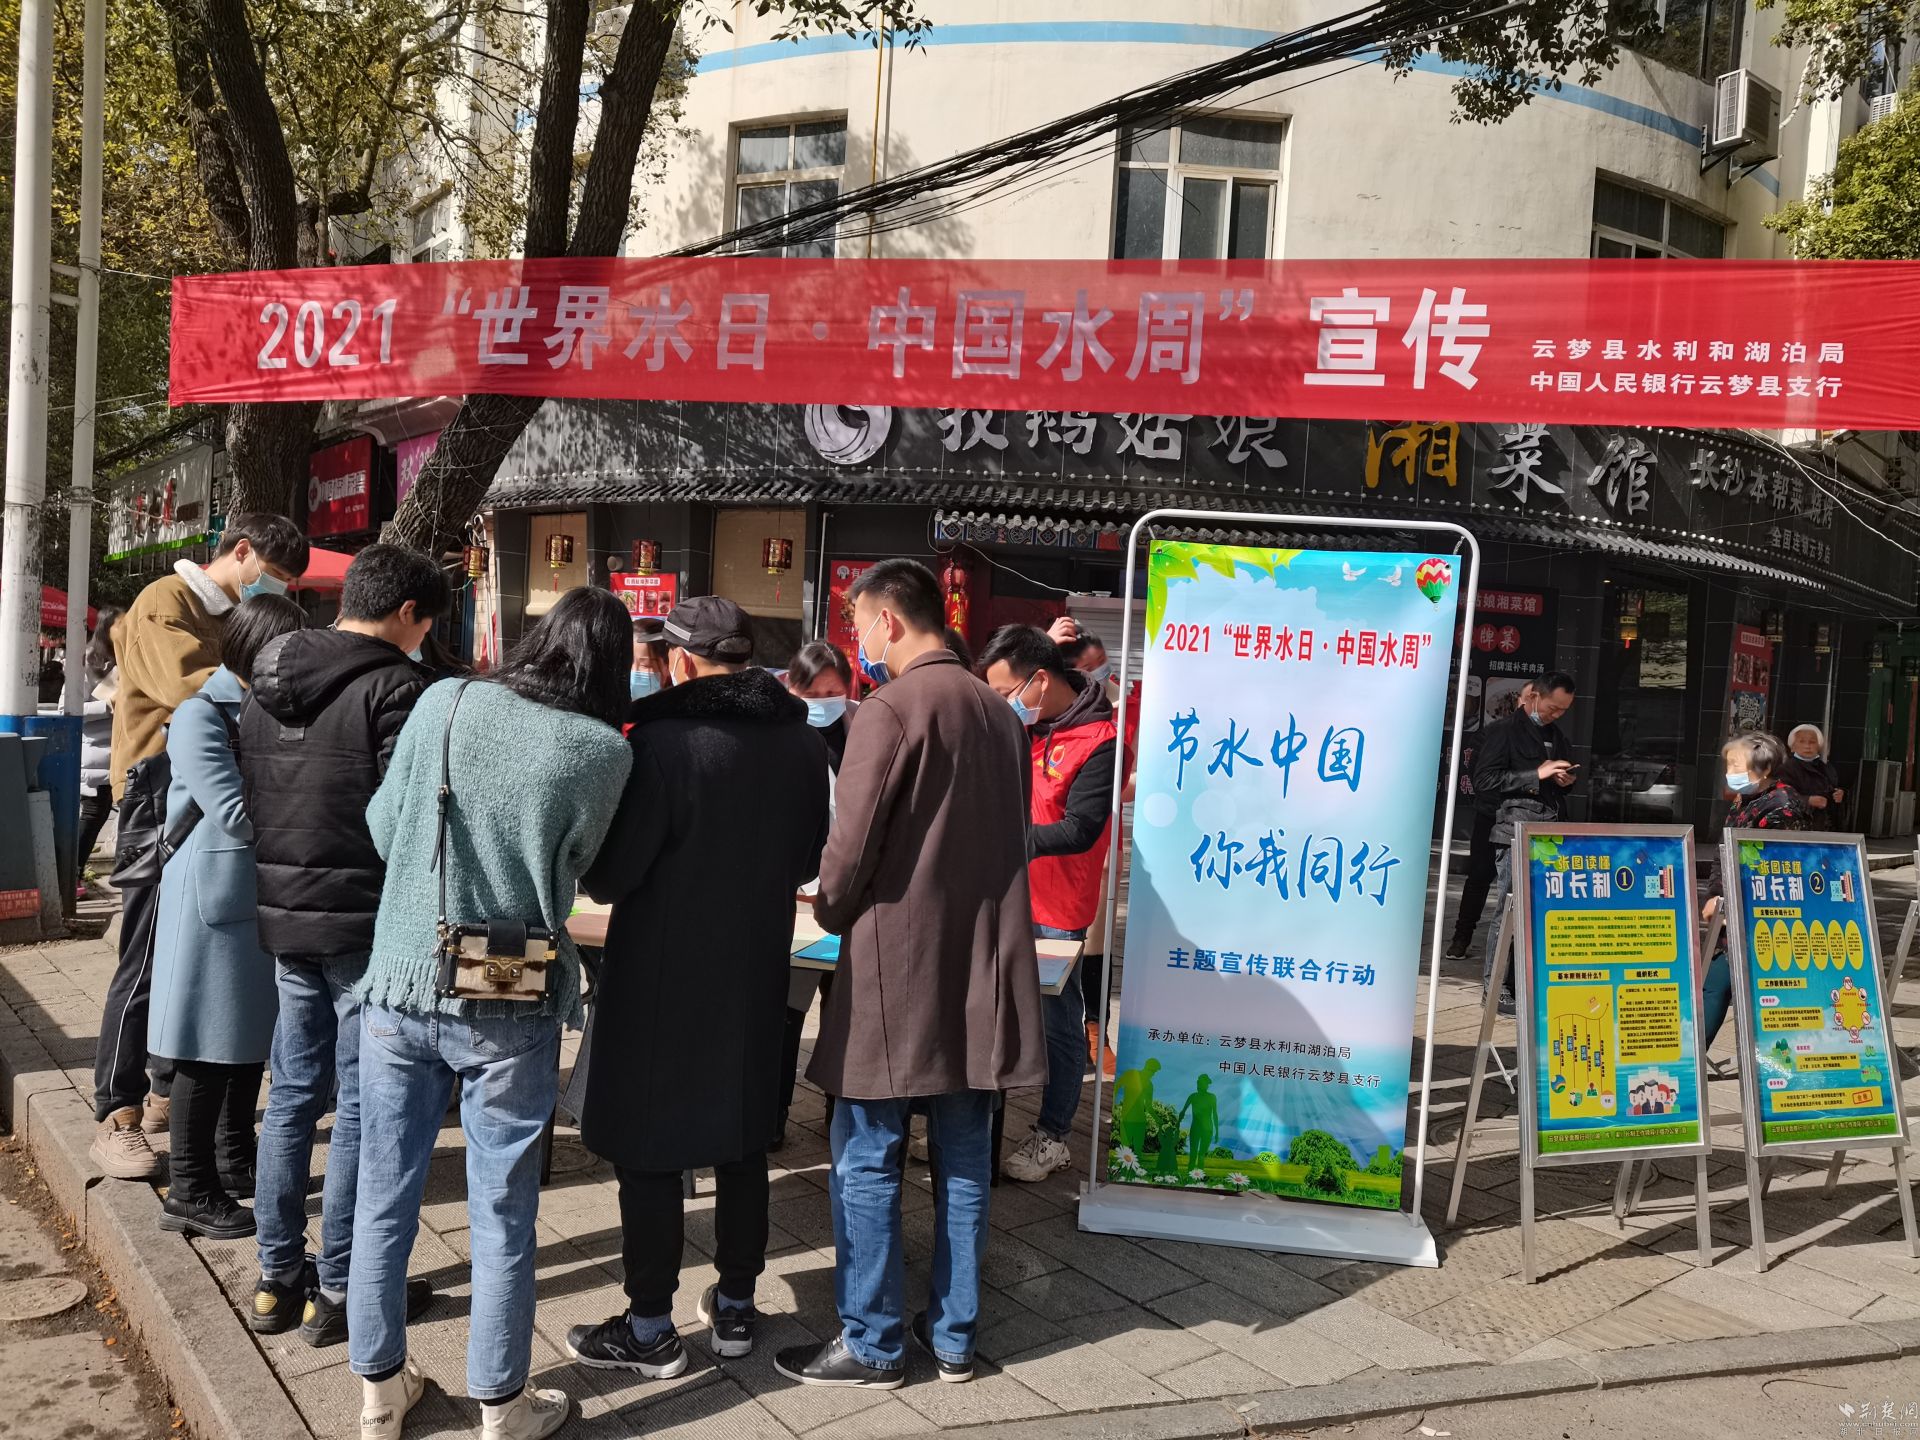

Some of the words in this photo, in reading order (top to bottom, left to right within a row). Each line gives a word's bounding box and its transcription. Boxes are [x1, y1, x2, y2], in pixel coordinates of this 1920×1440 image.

[256, 298, 396, 370] 2021
[1303, 287, 1490, 390] 宣传
[1532, 338, 1845, 364] 云梦县水利和湖泊局
[1530, 370, 1843, 398] 中国人民银行云梦县支行
[1164, 622, 1211, 653] 2021
[1489, 660, 1545, 674] 招牌滋补羊肉汤
[1167, 707, 1365, 799] 节水中国
[1190, 828, 1401, 907] 你我同行
[1545, 871, 1611, 899] 河长制
[1751, 875, 1804, 901] 河长制
[1167, 947, 1376, 986] 主题宣传联合行动
[1219, 1060, 1381, 1089] 中国人民银行云梦县支行
